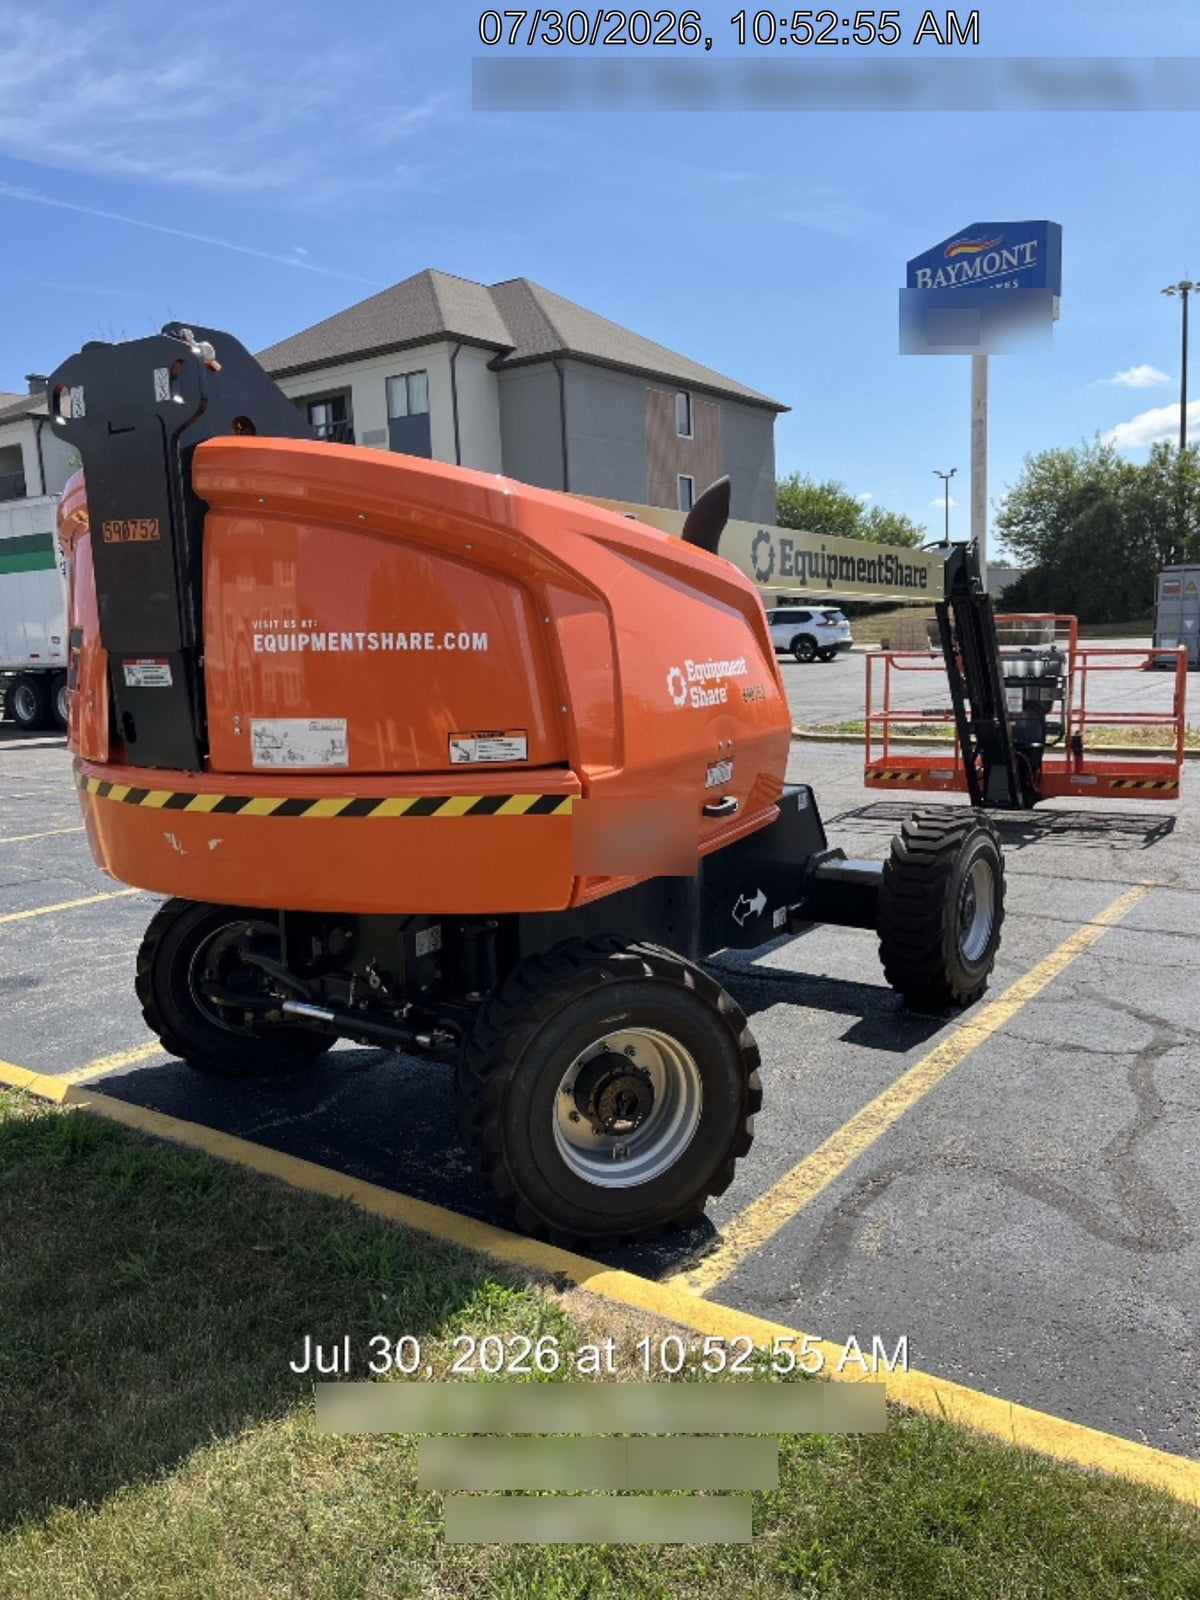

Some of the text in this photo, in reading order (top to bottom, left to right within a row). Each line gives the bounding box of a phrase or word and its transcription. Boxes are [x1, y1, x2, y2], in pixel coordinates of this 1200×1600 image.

[916, 240, 1038, 288] BAYMONT
[104, 520, 159, 541] 590752
[779, 538, 928, 589] EquipmentShare
[252, 619, 318, 629] VISIT US AT:
[252, 631, 489, 653] EQUIPMENTSHARE.COM
[684, 656, 748, 685] Equipment
[689, 685, 728, 708] Share
